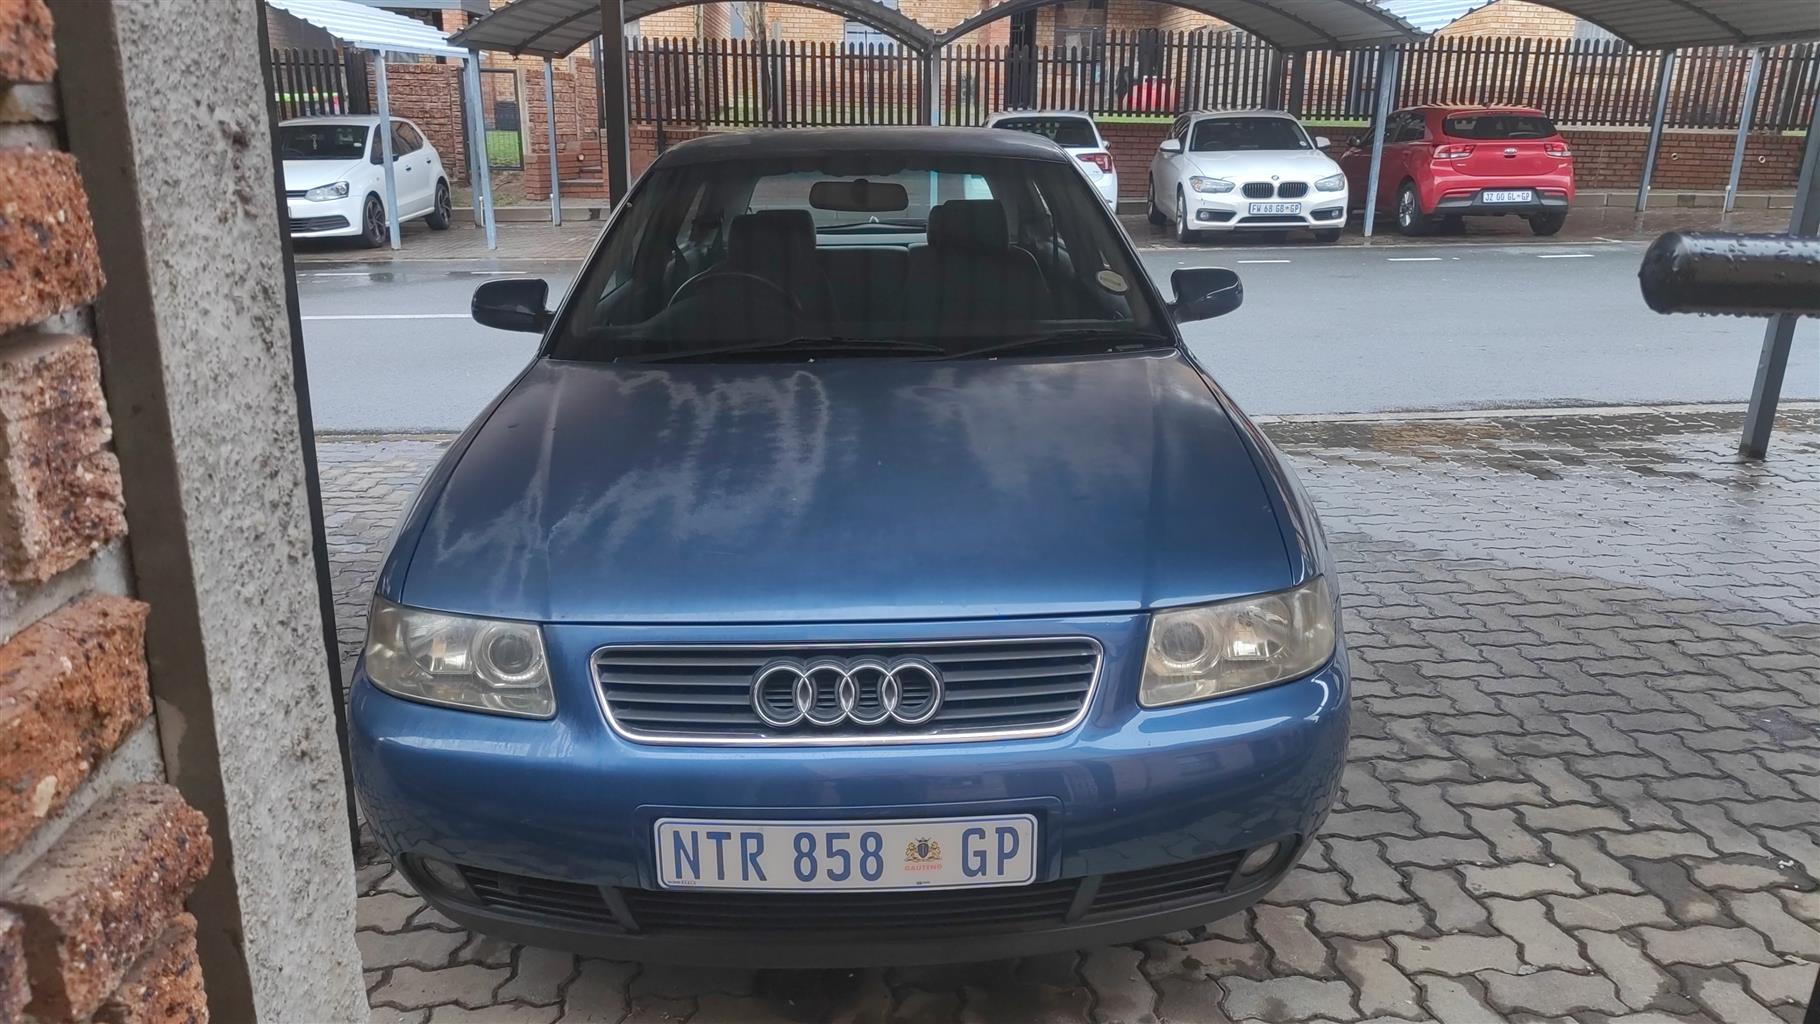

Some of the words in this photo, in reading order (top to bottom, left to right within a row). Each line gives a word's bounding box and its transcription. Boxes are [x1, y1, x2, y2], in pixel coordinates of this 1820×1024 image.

[1521, 192, 1530, 201] GP
[1252, 204, 1261, 213] FW
[1290, 204, 1300, 213] GP
[672, 830, 768, 881] NTR
[792, 831, 885, 882] 858
[961, 826, 1021, 878] GP
